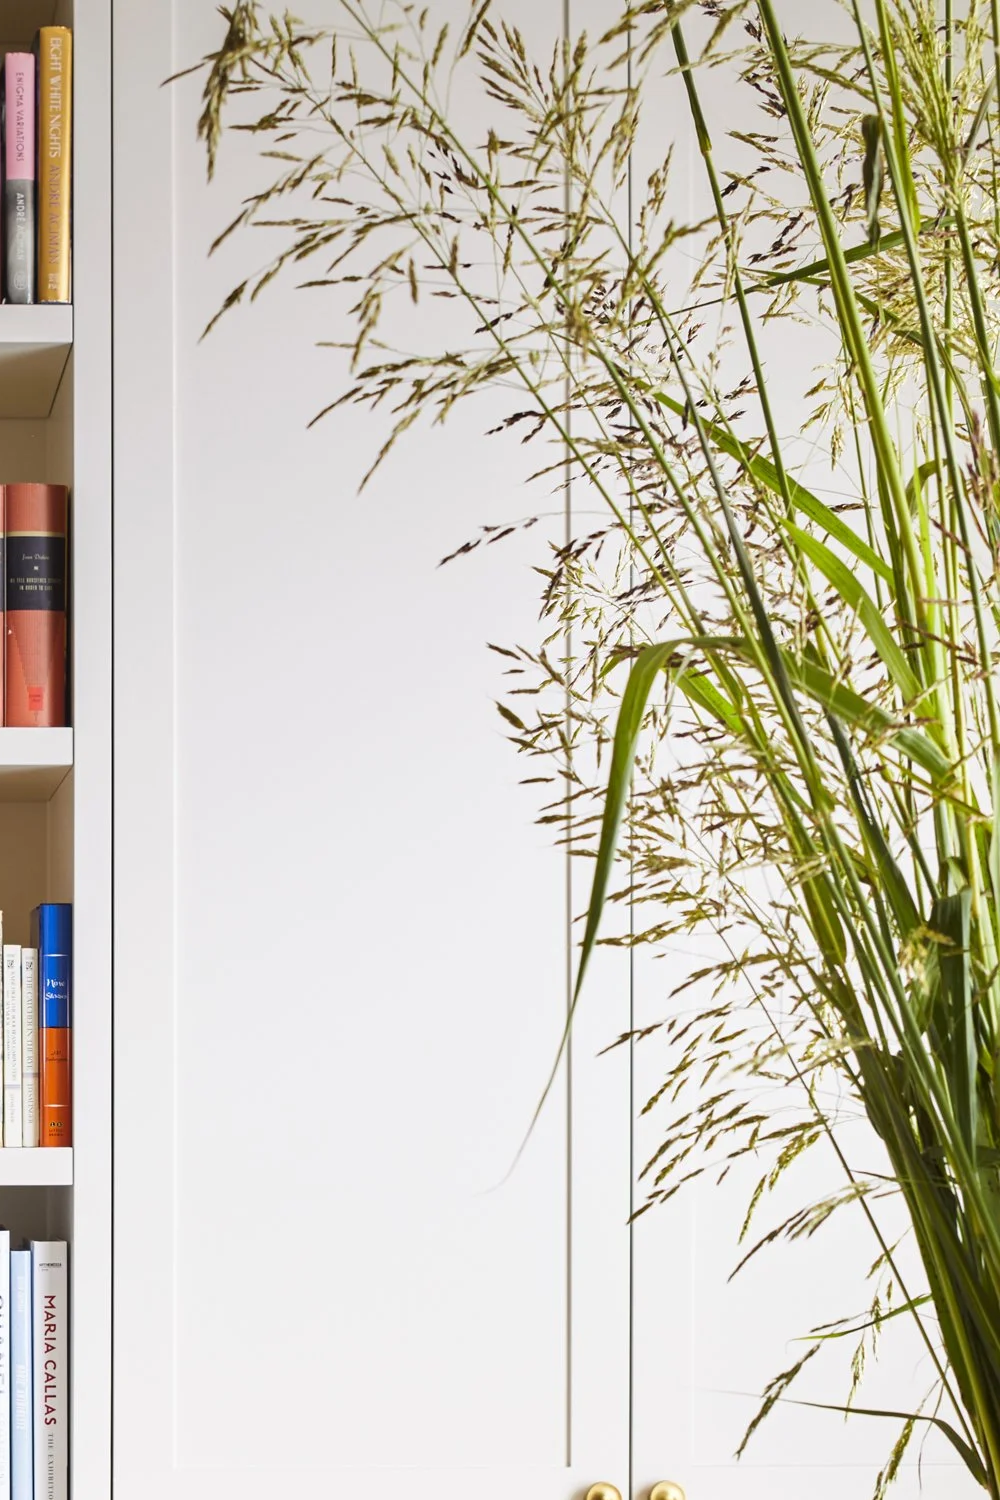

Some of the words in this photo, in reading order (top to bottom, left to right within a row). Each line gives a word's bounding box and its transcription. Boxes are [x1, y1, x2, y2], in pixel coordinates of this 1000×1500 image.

[15, 72, 25, 107] ENIGMA
[15, 110, 25, 162] VARIATIONS
[16, 192, 28, 222] ANDRÉ
[16, 224, 26, 260] ACIMAN
[43, 1295, 57, 1354] MARIA
[43, 1360, 57, 1426] CALLAS
[47, 1433, 55, 1451] THE
